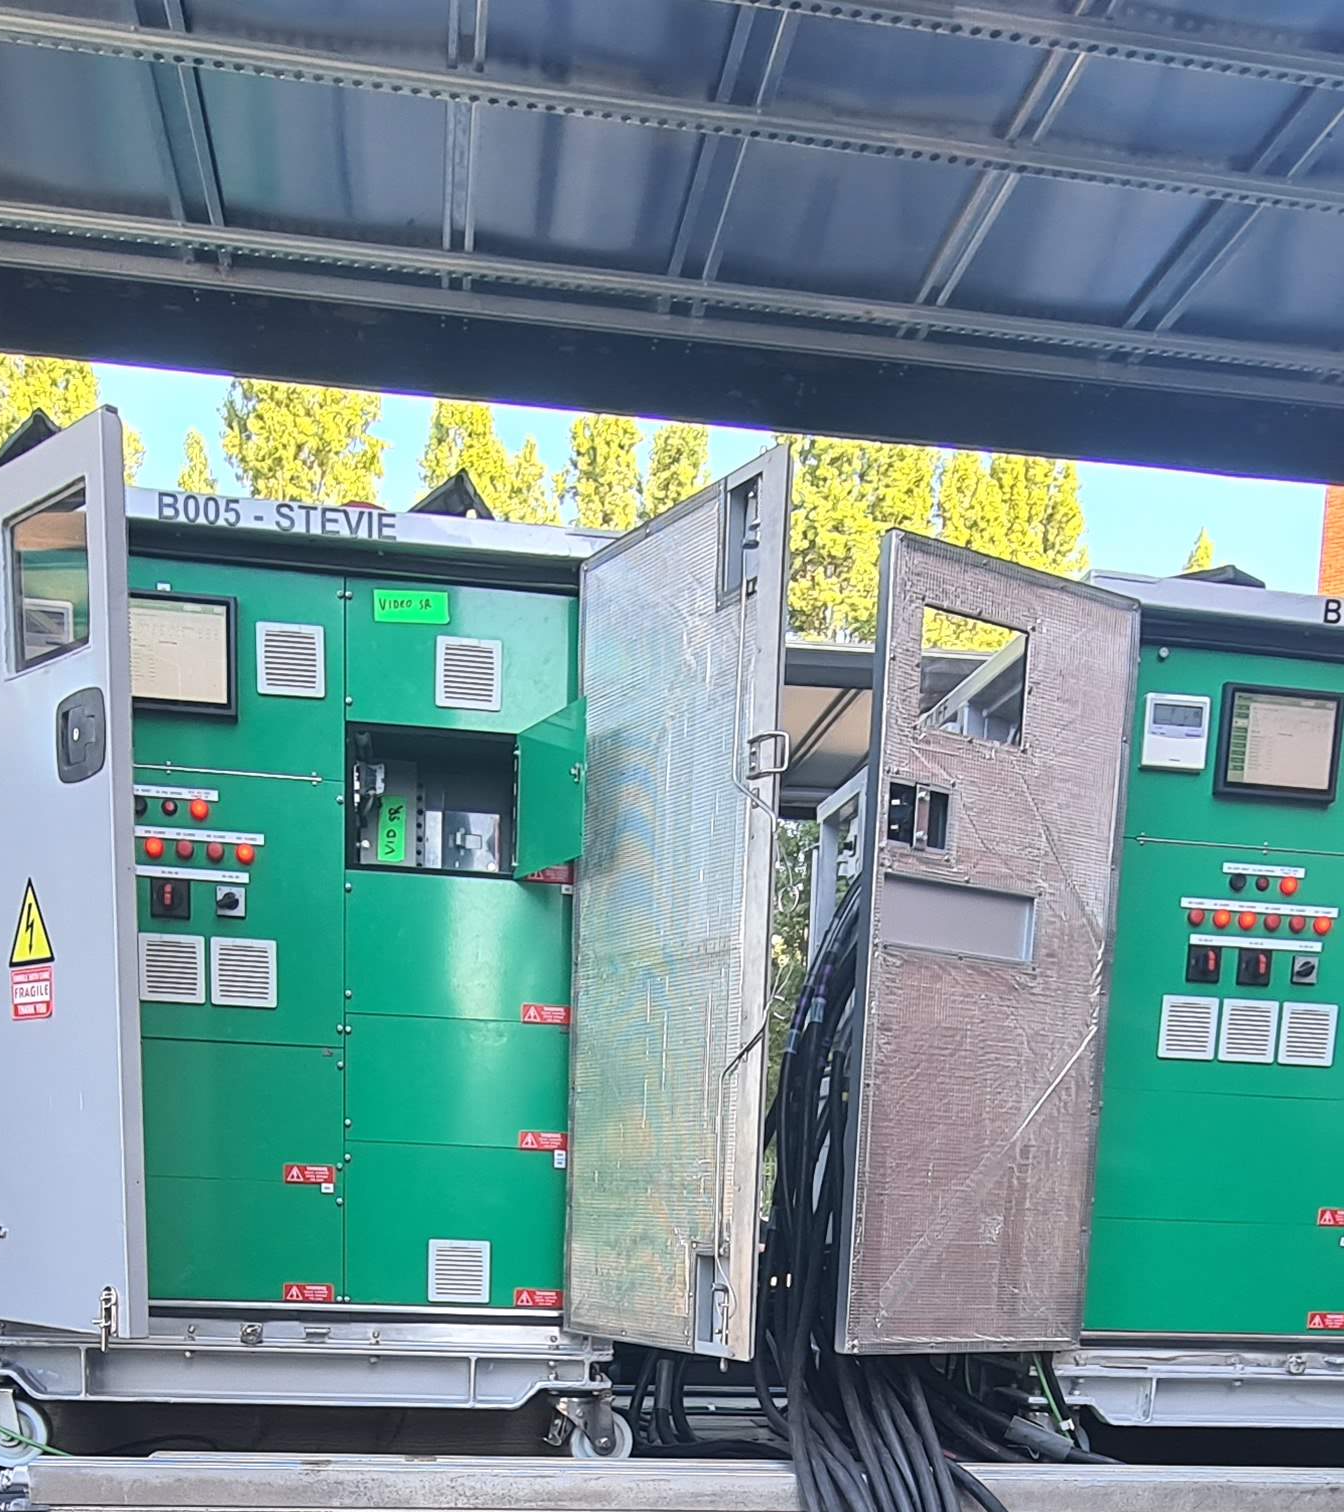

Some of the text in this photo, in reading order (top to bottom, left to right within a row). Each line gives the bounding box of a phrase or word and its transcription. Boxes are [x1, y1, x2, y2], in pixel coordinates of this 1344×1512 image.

[158, 492, 397, 541] B005 - STEVIE
[378, 597, 413, 611] VIDEO
[384, 828, 397, 856] VID
[14, 984, 49, 999] FRAGILE
